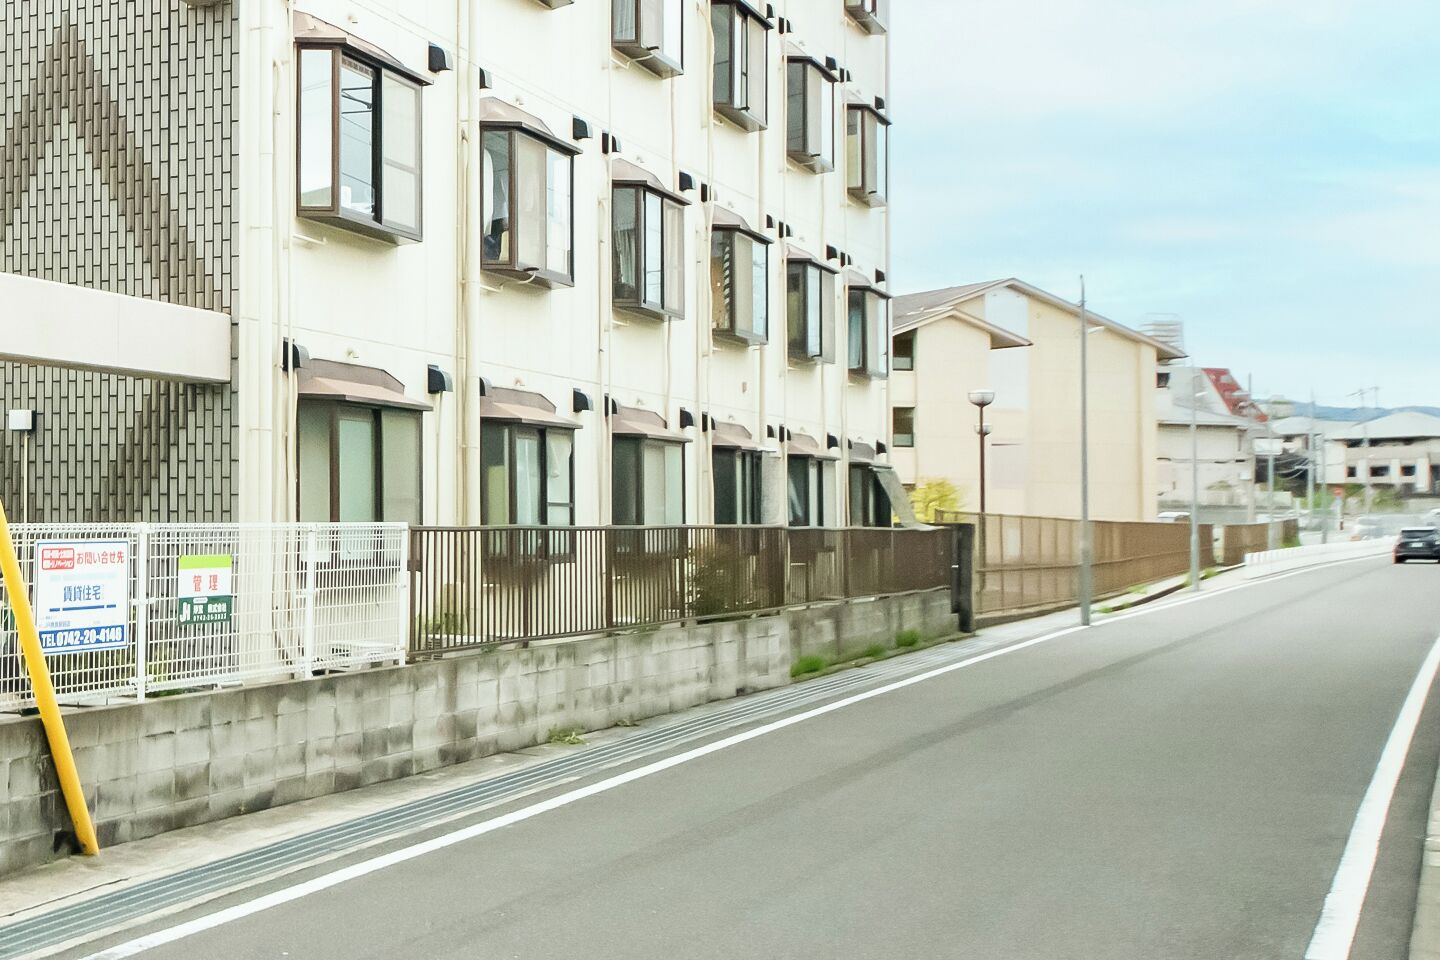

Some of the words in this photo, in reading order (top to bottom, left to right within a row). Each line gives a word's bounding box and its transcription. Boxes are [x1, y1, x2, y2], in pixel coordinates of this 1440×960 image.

[76, 551, 125, 565] お問い合せ先
[192, 574, 218, 592] 管理
[63, 585, 102, 603] 賃貸住宅
